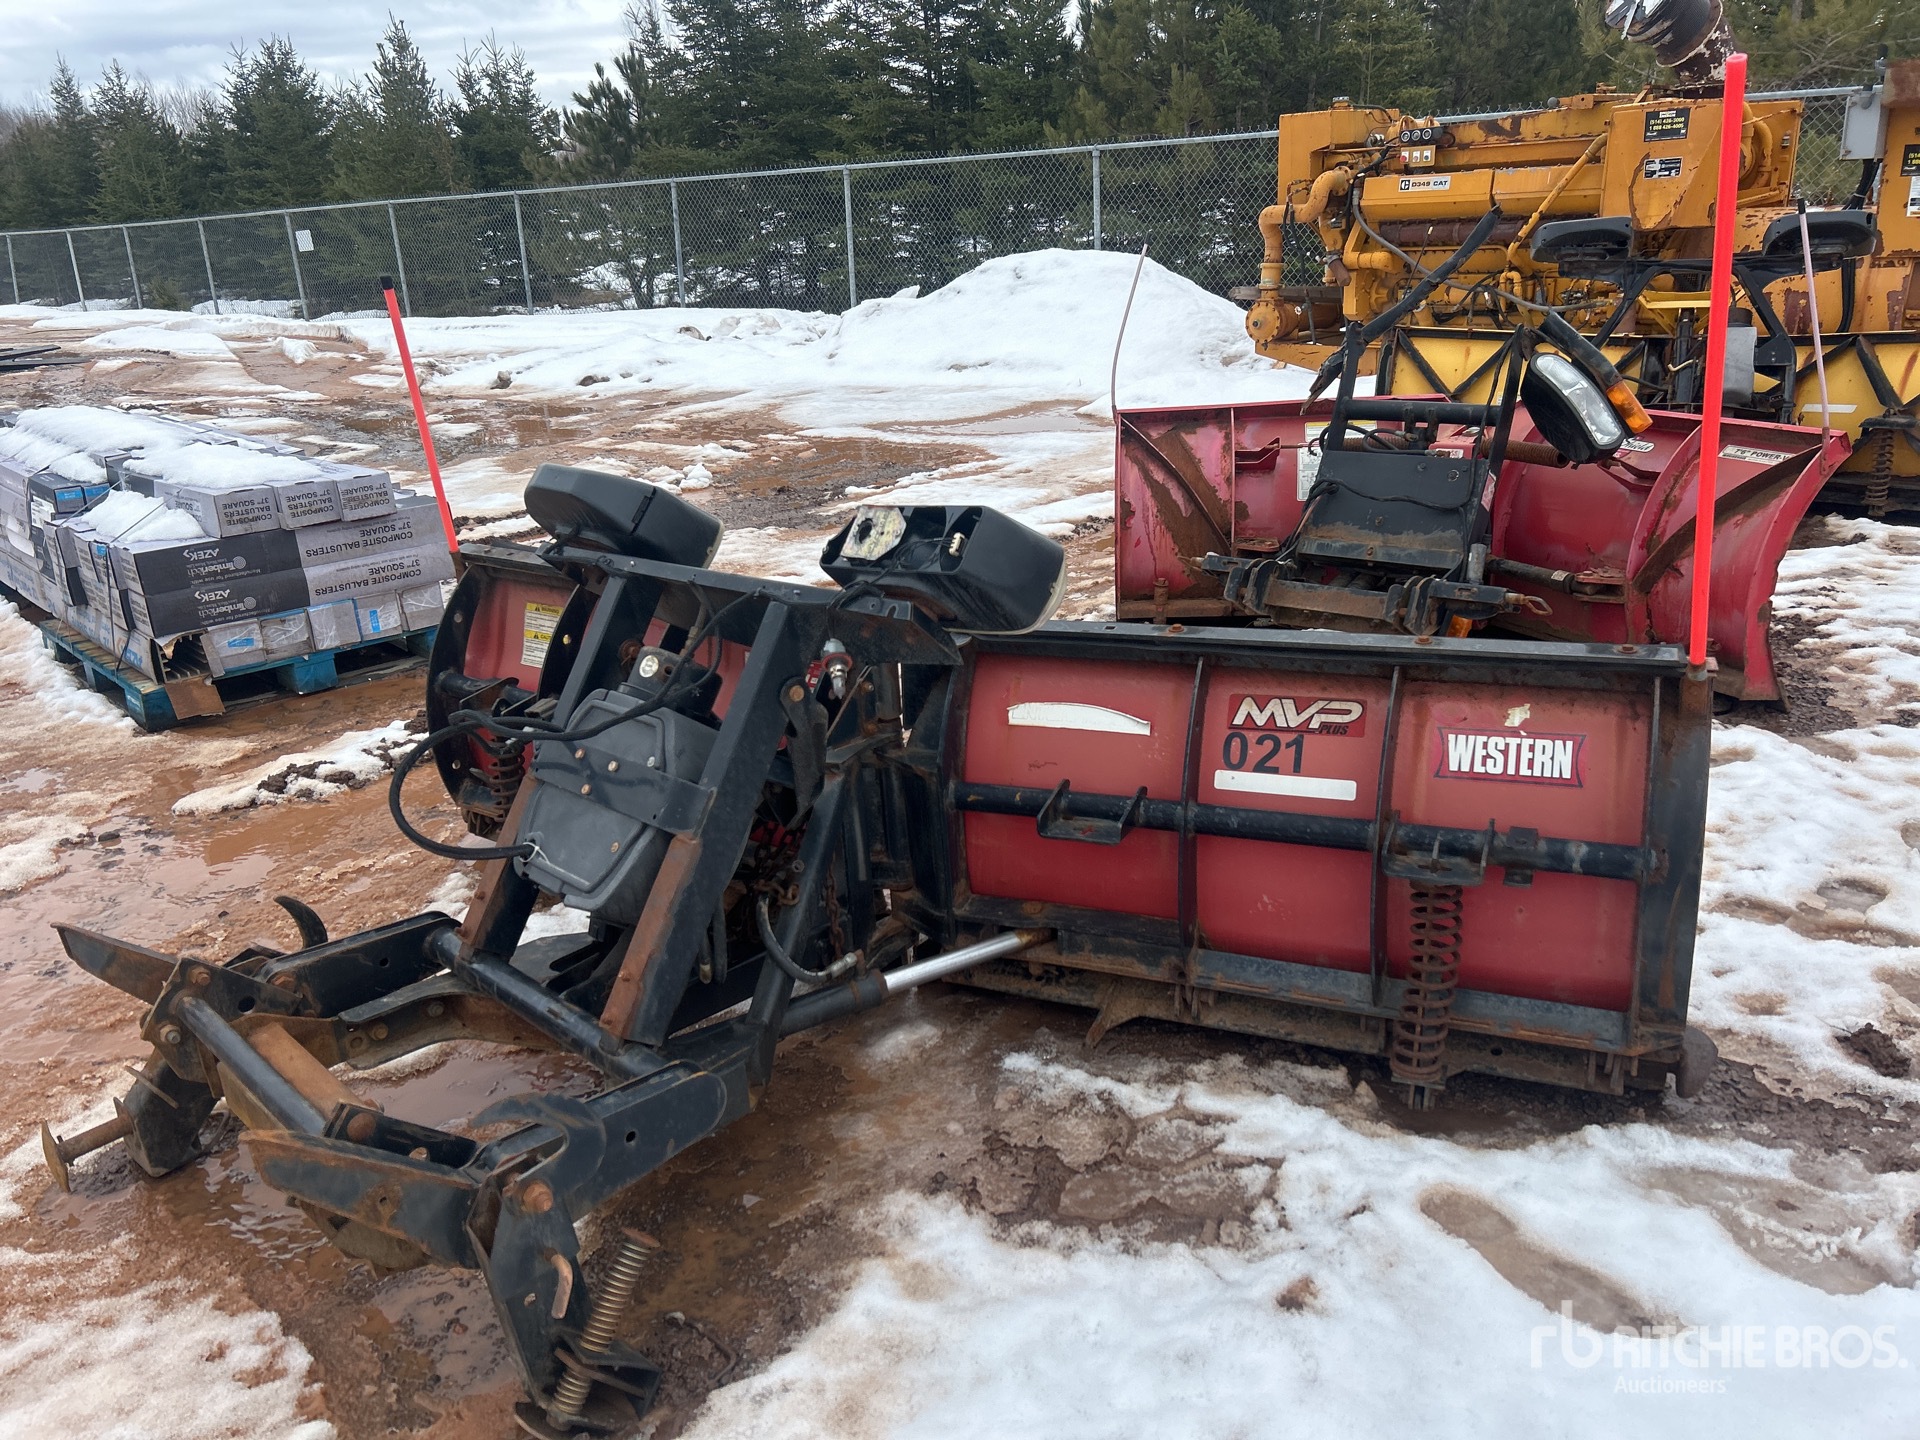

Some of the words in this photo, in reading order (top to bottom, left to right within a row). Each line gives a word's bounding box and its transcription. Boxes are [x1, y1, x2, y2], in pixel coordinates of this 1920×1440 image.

[285, 491, 318, 502] SQUARE
[288, 496, 333, 510] BALUSTERS
[222, 500, 256, 510] SQUARE
[224, 505, 271, 518] BALUSTERS
[290, 504, 334, 518] COMPOSITE
[226, 513, 273, 526] COMPOSITE
[360, 524, 396, 538] SQUARE
[362, 530, 414, 548] COMPOSITE
[189, 548, 220, 561] AZEK
[306, 542, 361, 558] BALUSTERS
[368, 562, 405, 576] SQUARE
[371, 569, 422, 586] COMPOSITE
[314, 577, 369, 596] BALUSTERS
[201, 588, 230, 602] AZEK
[1230, 695, 1365, 730] MVP
[1318, 724, 1349, 736] PLUS
[1222, 731, 1305, 774] 021
[1447, 733, 1574, 780] WESTERN
